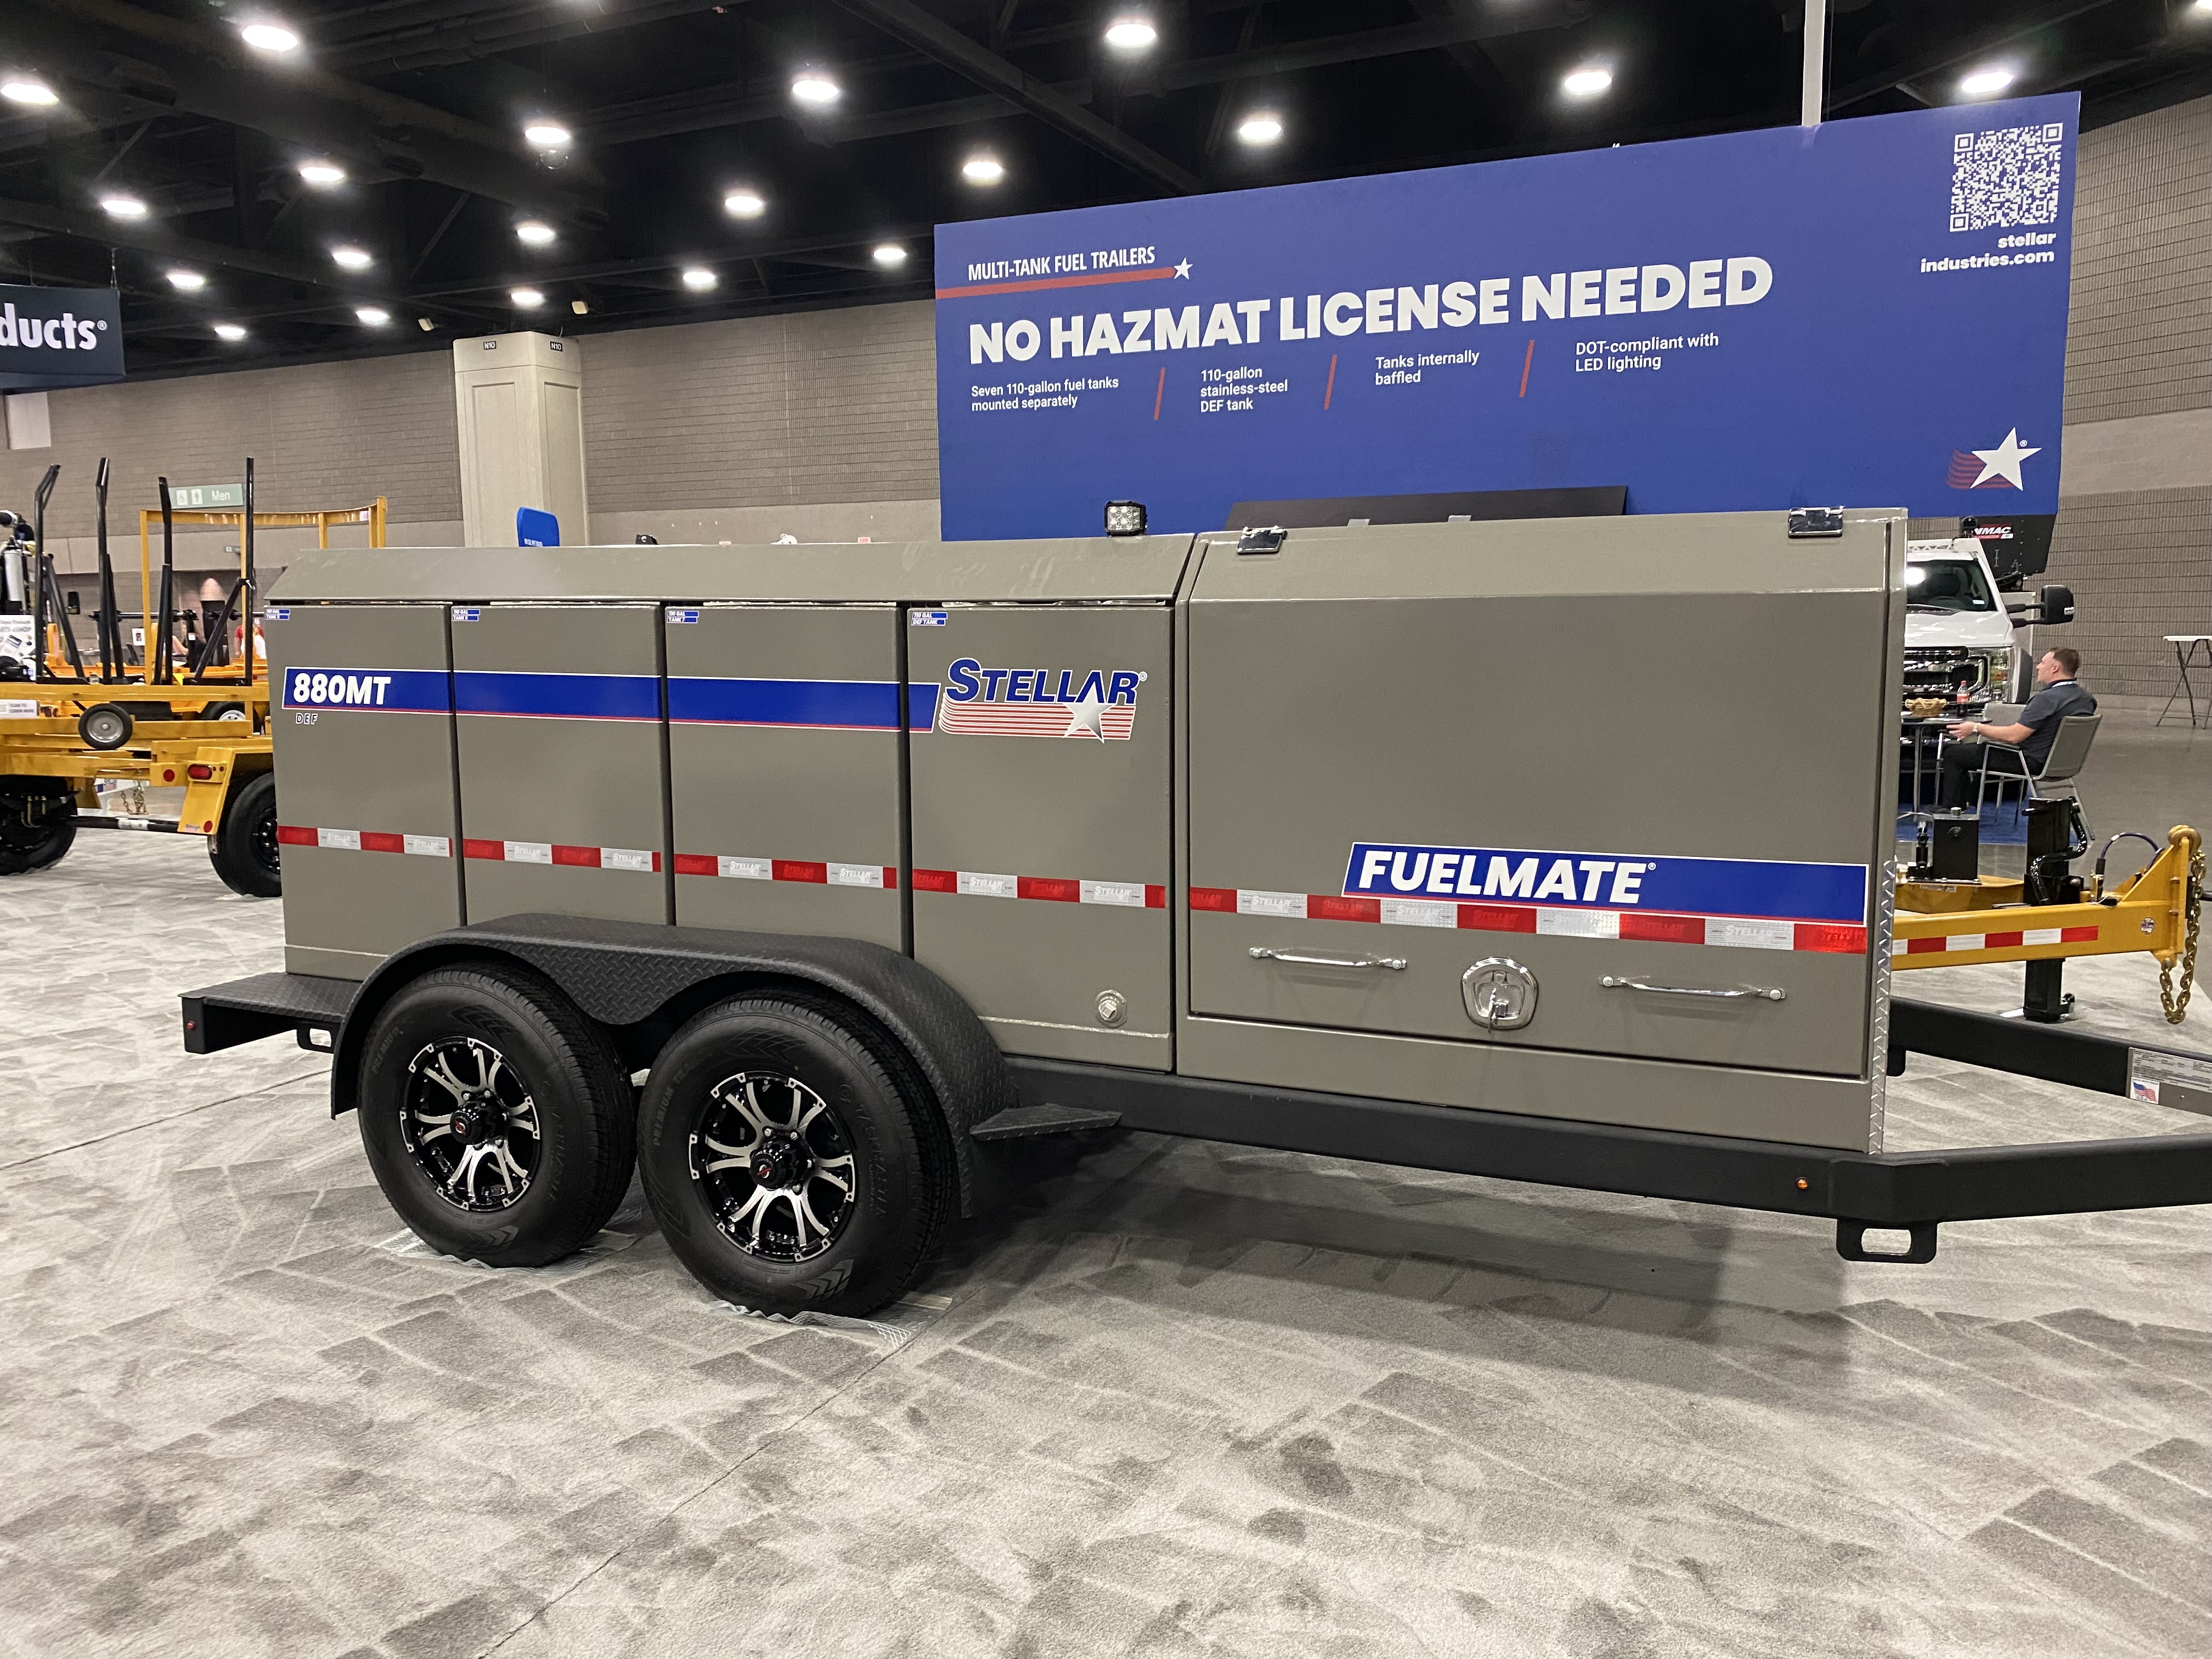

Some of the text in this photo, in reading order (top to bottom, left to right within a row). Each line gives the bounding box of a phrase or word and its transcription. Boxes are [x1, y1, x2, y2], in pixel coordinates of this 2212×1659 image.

[1997, 232, 2056, 249] stellar
[968, 246, 1155, 281] MULTI-TANK FUEL TRAILERS
[1920, 251, 2054, 273] industries.com
[969, 256, 1774, 364] NO HAZMAT LICENSE NEEDED
[1576, 332, 1719, 356] DOT-compliant with
[1375, 349, 1480, 369] Tanks internally
[1576, 354, 1661, 373] LED lighting
[1201, 366, 1262, 383] 110-gallon
[1375, 370, 1421, 386] baffled
[971, 376, 1119, 397] Seven 110-gallon fuel tanks
[1200, 379, 1288, 397] stainless-steel
[972, 394, 1077, 412] mounted separately
[1200, 397, 1253, 413] DEF tank
[212, 490, 230, 501] Men
[1974, 527, 2012, 535] VMAC
[293, 673, 391, 706] 880MT
[295, 712, 318, 725] DEF
[730, 861, 761, 871] STELLAR
[839, 867, 872, 878] STELLAR
[970, 876, 1006, 888] STELLAR
[1094, 885, 1132, 896] STELLAR
[1251, 896, 1291, 907] STELLAR
[1397, 905, 1440, 916] STELLAR
